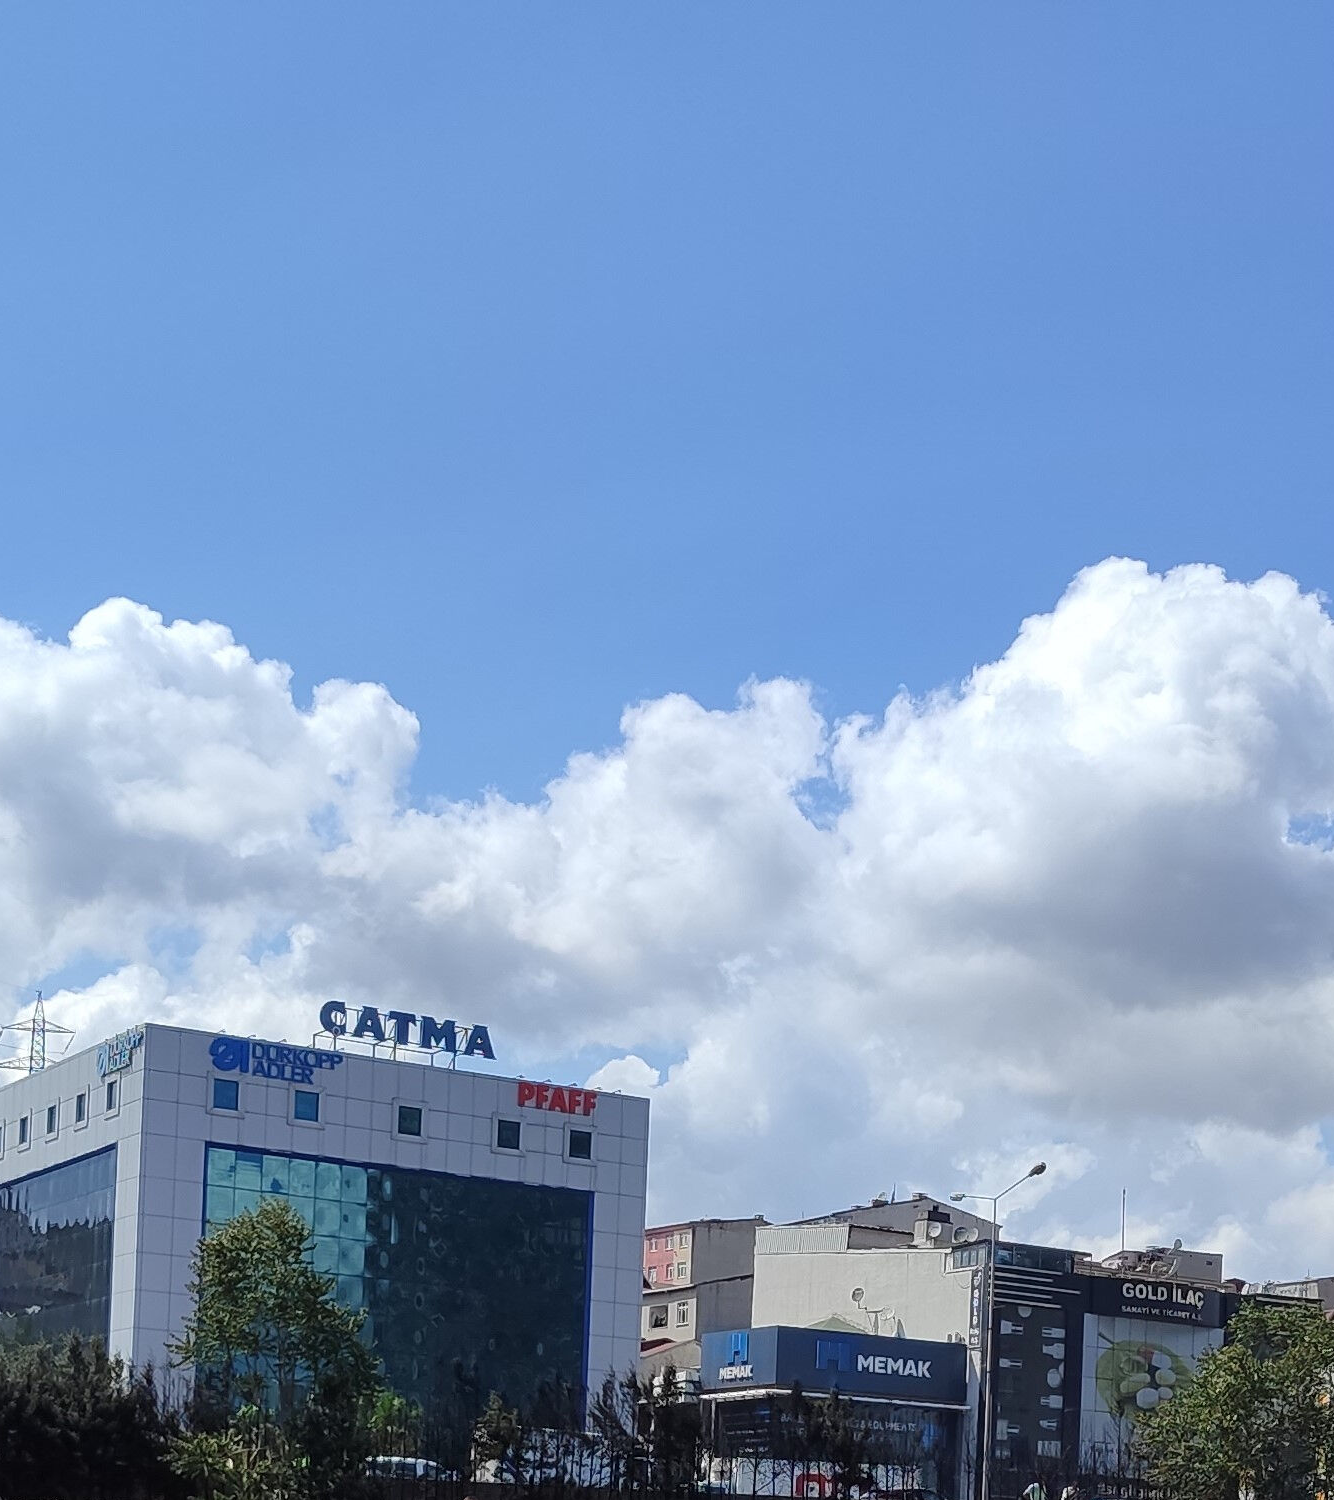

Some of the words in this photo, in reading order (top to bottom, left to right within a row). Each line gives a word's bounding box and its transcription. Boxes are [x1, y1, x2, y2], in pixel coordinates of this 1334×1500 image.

[252, 1059, 314, 1085] ADLER
[518, 1082, 597, 1116] PFAFF
[1122, 1283, 1167, 1301] GOLD
[718, 1364, 753, 1380] MEMAK
[857, 1354, 932, 1379] MEMAK
